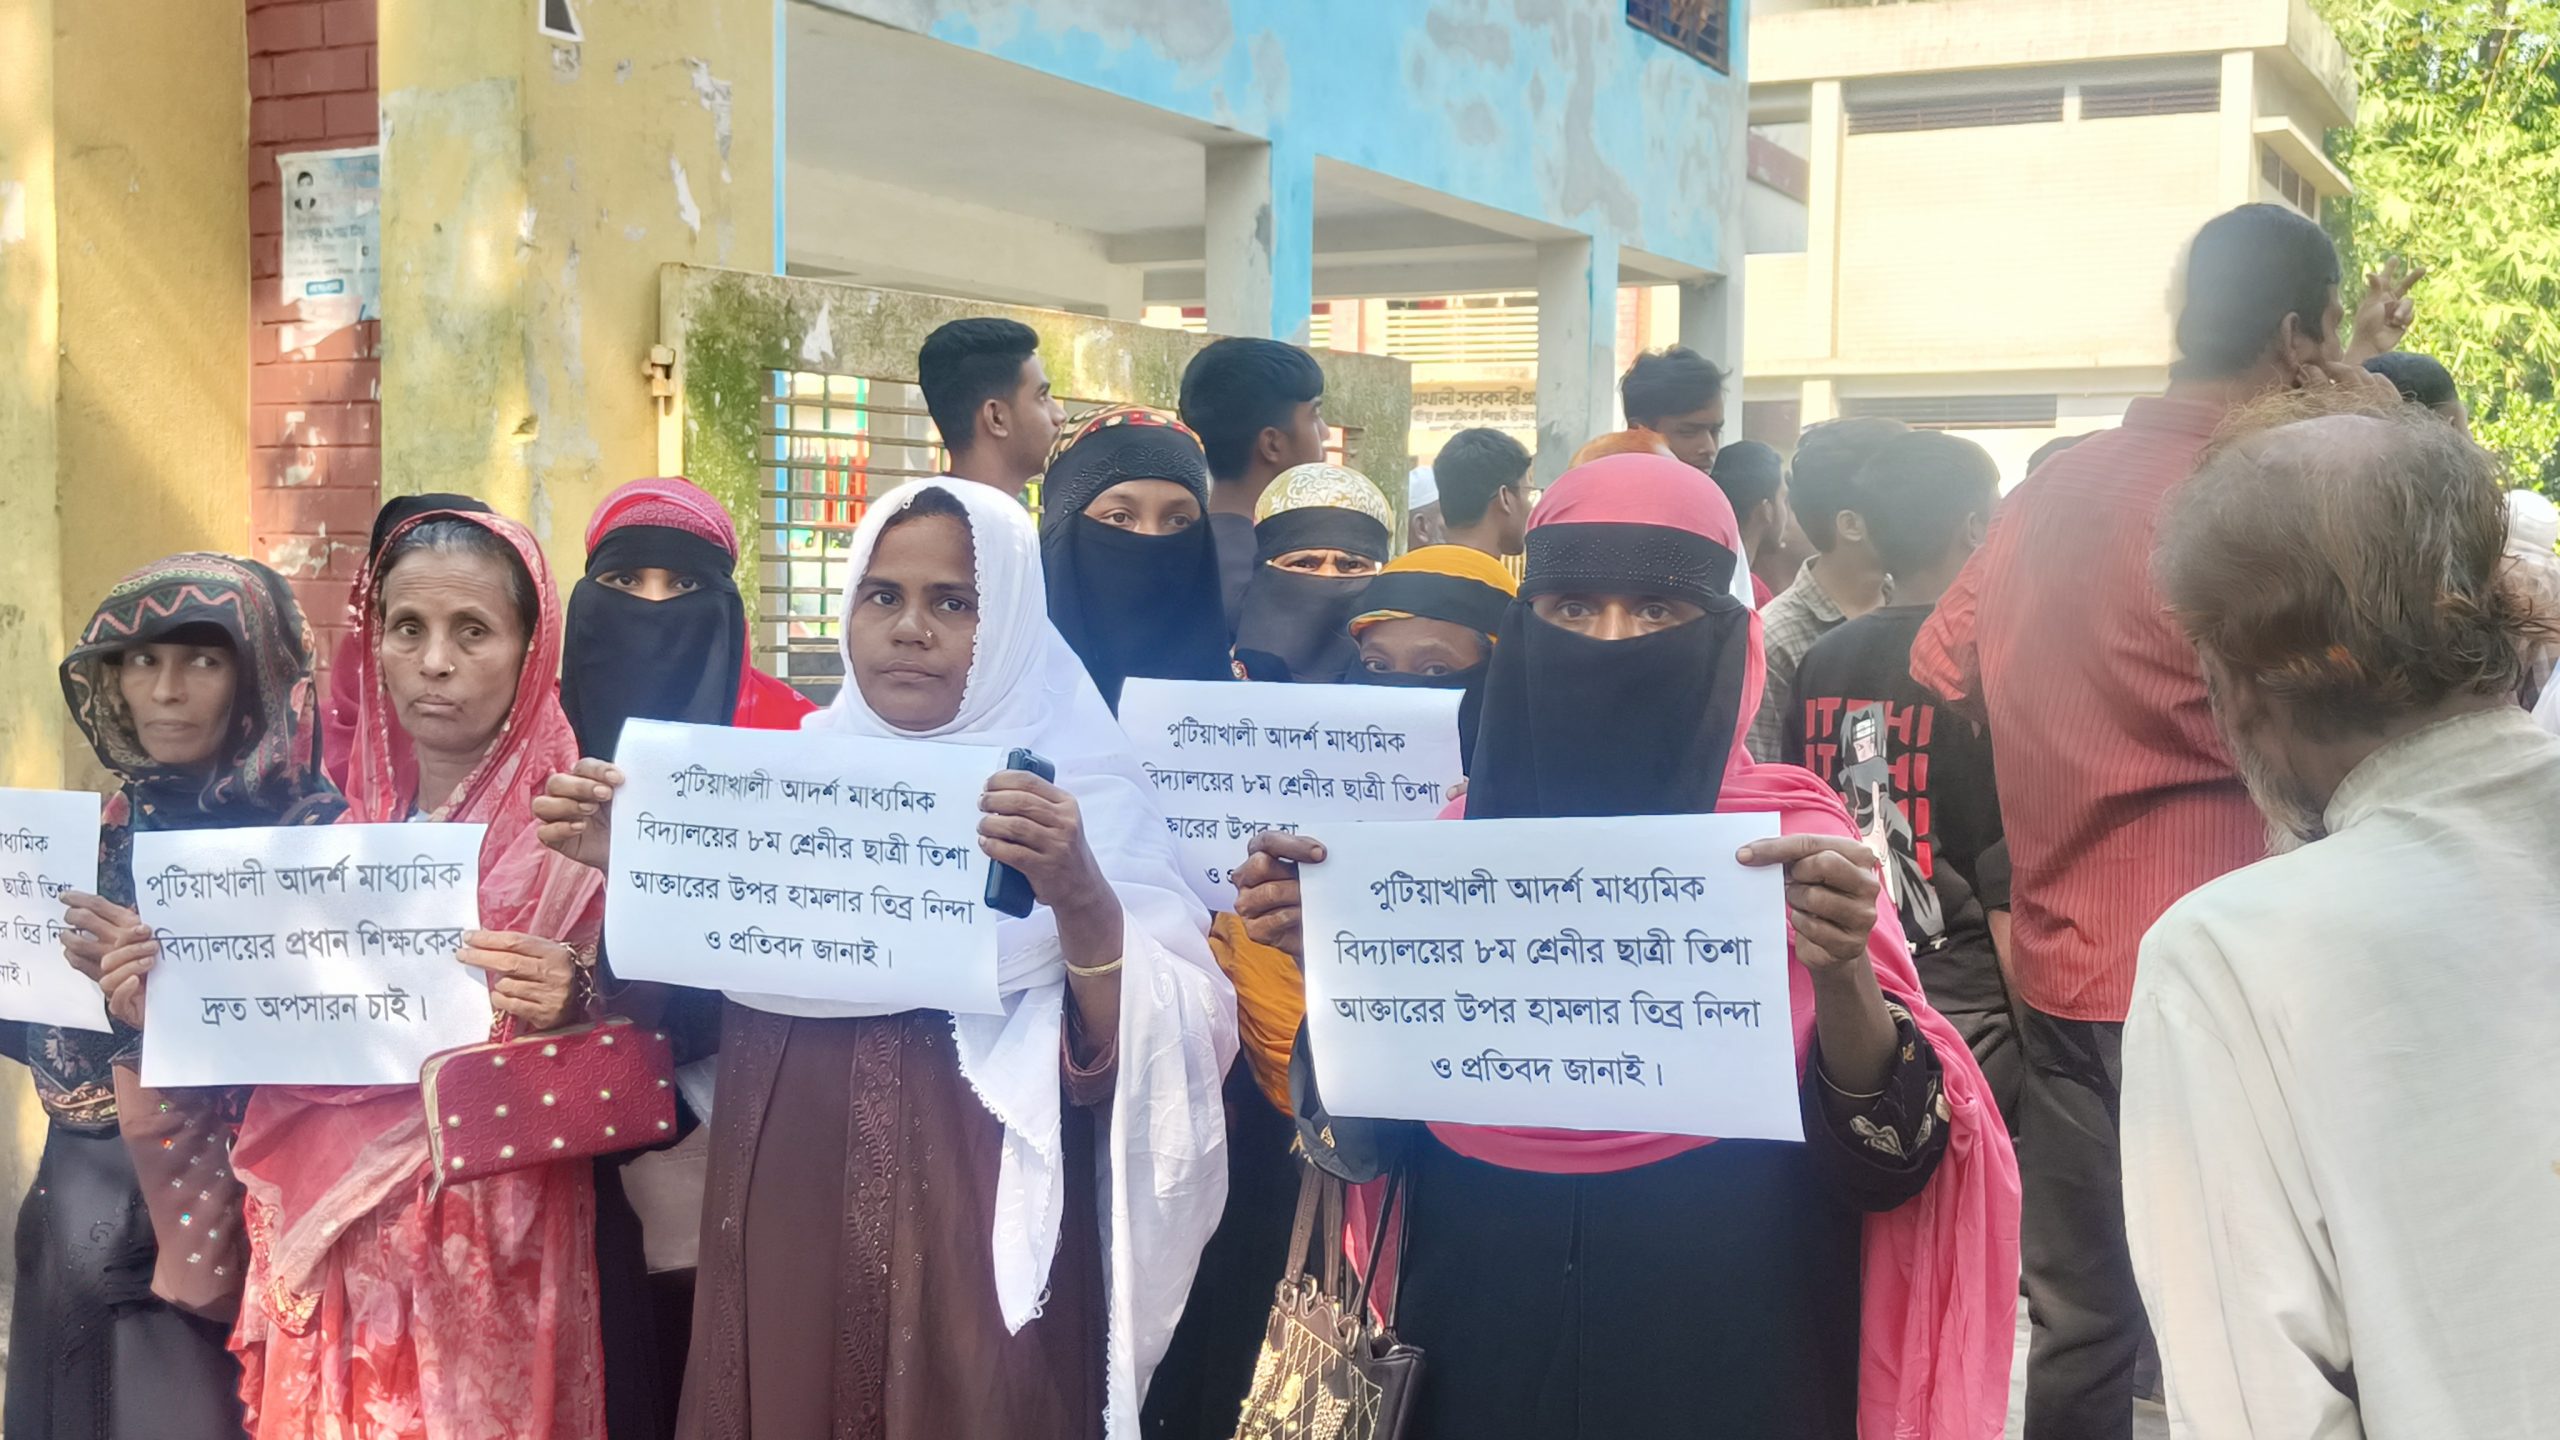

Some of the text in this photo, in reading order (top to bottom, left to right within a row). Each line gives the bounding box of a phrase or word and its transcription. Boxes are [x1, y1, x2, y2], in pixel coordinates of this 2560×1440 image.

[1166, 715, 1406, 754] পুটিয়াখালী আদর্শ মাধ্যমিক
[1805, 697, 1934, 748] ITHI
[670, 763, 937, 814] পুটিয়াখালী আদর্শ মাধ্যমিক
[1240, 774, 1272, 795] ৮ম
[1340, 771, 1386, 803] ছাত্রী
[1390, 773, 1441, 805] তিশা
[636, 811, 740, 849] বিদ্যালয়ের
[747, 829, 783, 853] ৮ম
[861, 832, 910, 866] ছাত্রী
[915, 835, 971, 871] তিশা
[2, 871, 34, 899] ছাত্রী
[146, 853, 464, 907] পুটিয়াখালী আদর্শ মাধ্যমিক
[1204, 867, 1221, 885] ও
[1369, 866, 1707, 913] পুটিয়াখালী আদর্শ মাধ্যমিক
[629, 870, 976, 925] আক্তারের উপর হামলার তিব্র নিন্দা
[154, 927, 276, 963] বিদ্যালয়ের
[285, 927, 348, 960] প্রধান
[704, 930, 722, 950] ও
[1332, 929, 1465, 966] বিদ্যালয়ের
[1474, 938, 1517, 964] ৮ম
[1612, 927, 1676, 968] ছাত্রী
[1682, 928, 1753, 966] তিশা
[1330, 989, 1762, 1031] আক্তারের উপর হামলার তিব্র নিন্দা
[1430, 1056, 1453, 1080] ও
